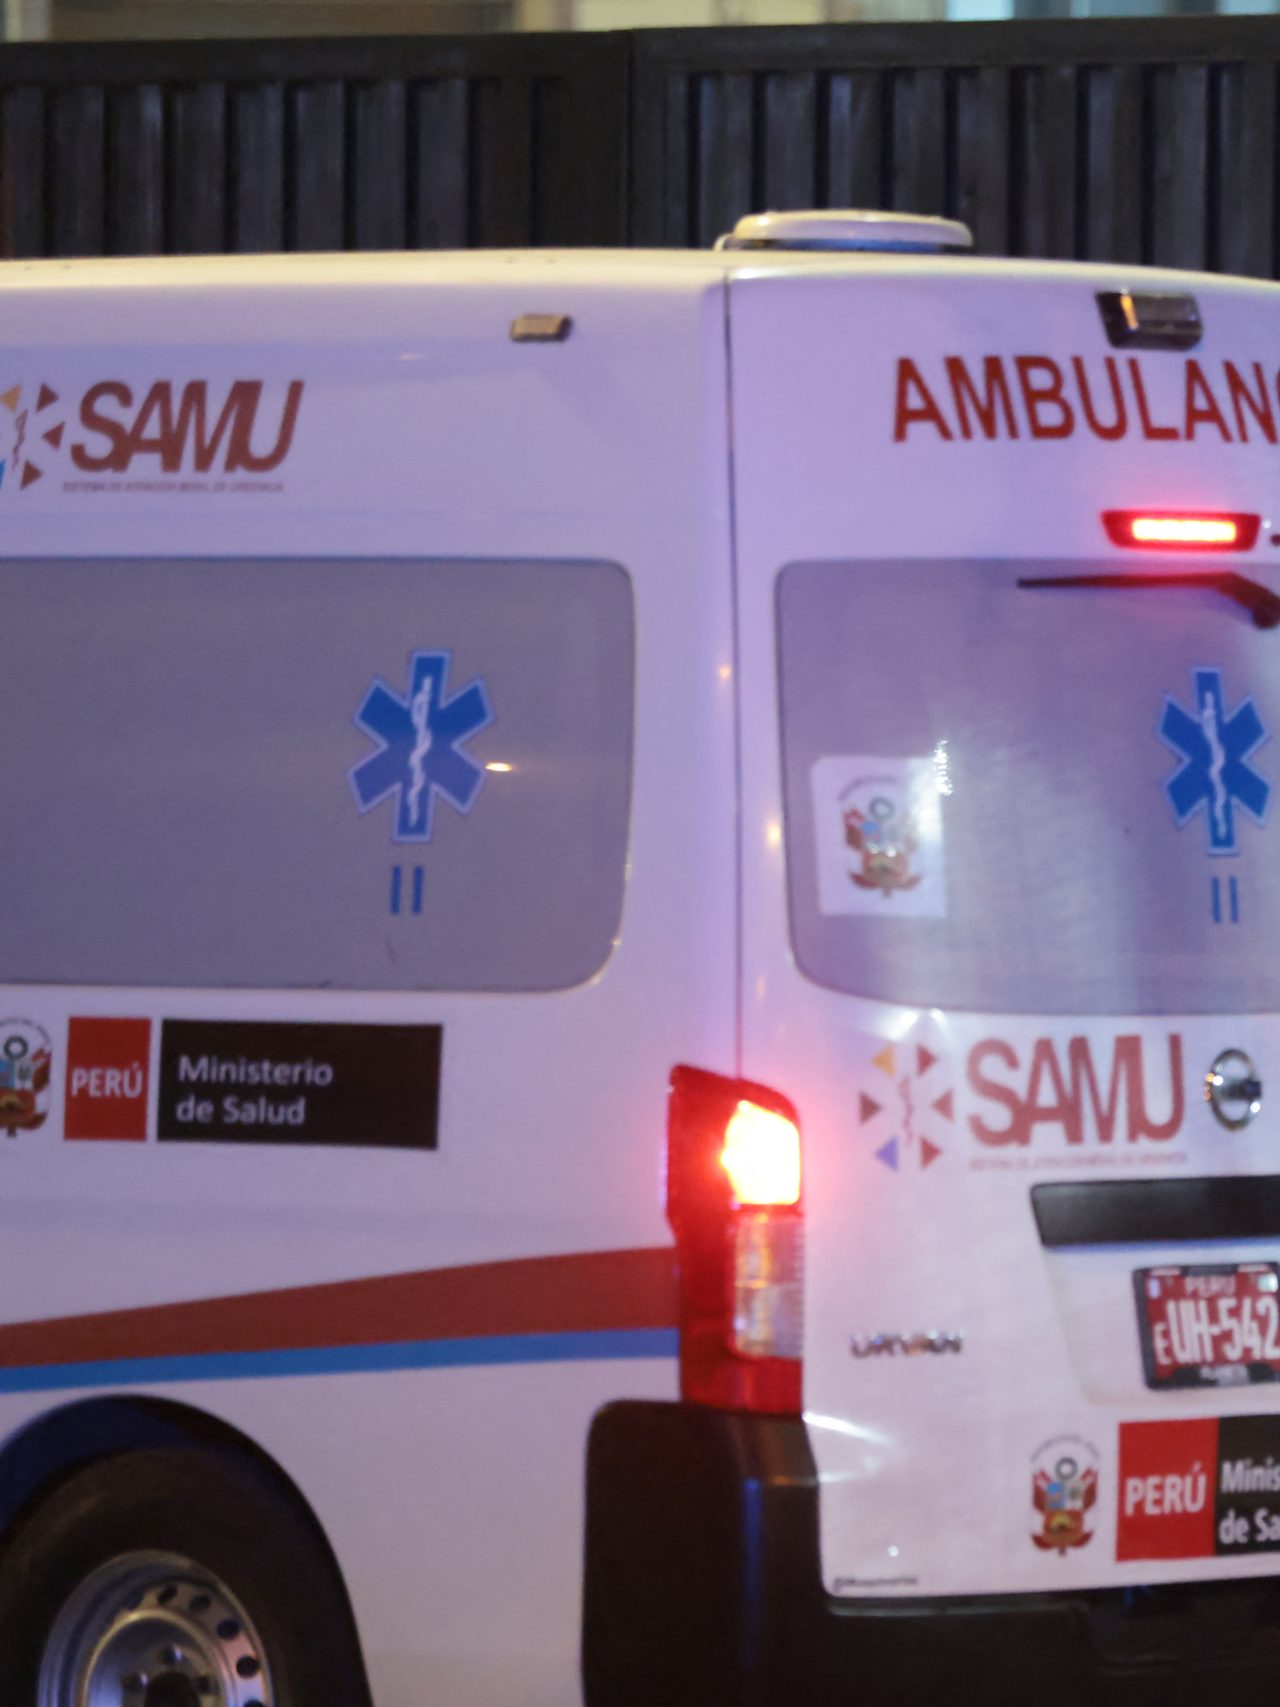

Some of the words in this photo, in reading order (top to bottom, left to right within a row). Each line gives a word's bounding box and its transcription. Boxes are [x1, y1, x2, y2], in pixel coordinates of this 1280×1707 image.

[70, 379, 305, 473] SAMU
[71, 1063, 143, 1098] PERÚ
[178, 1055, 334, 1088] Ministerio
[966, 1033, 1185, 1146] SAMU
[175, 1096, 214, 1126] de
[222, 1096, 306, 1126] Salud
[1125, 1468, 1207, 1517] PERÚ
[1219, 1510, 1250, 1543] de
